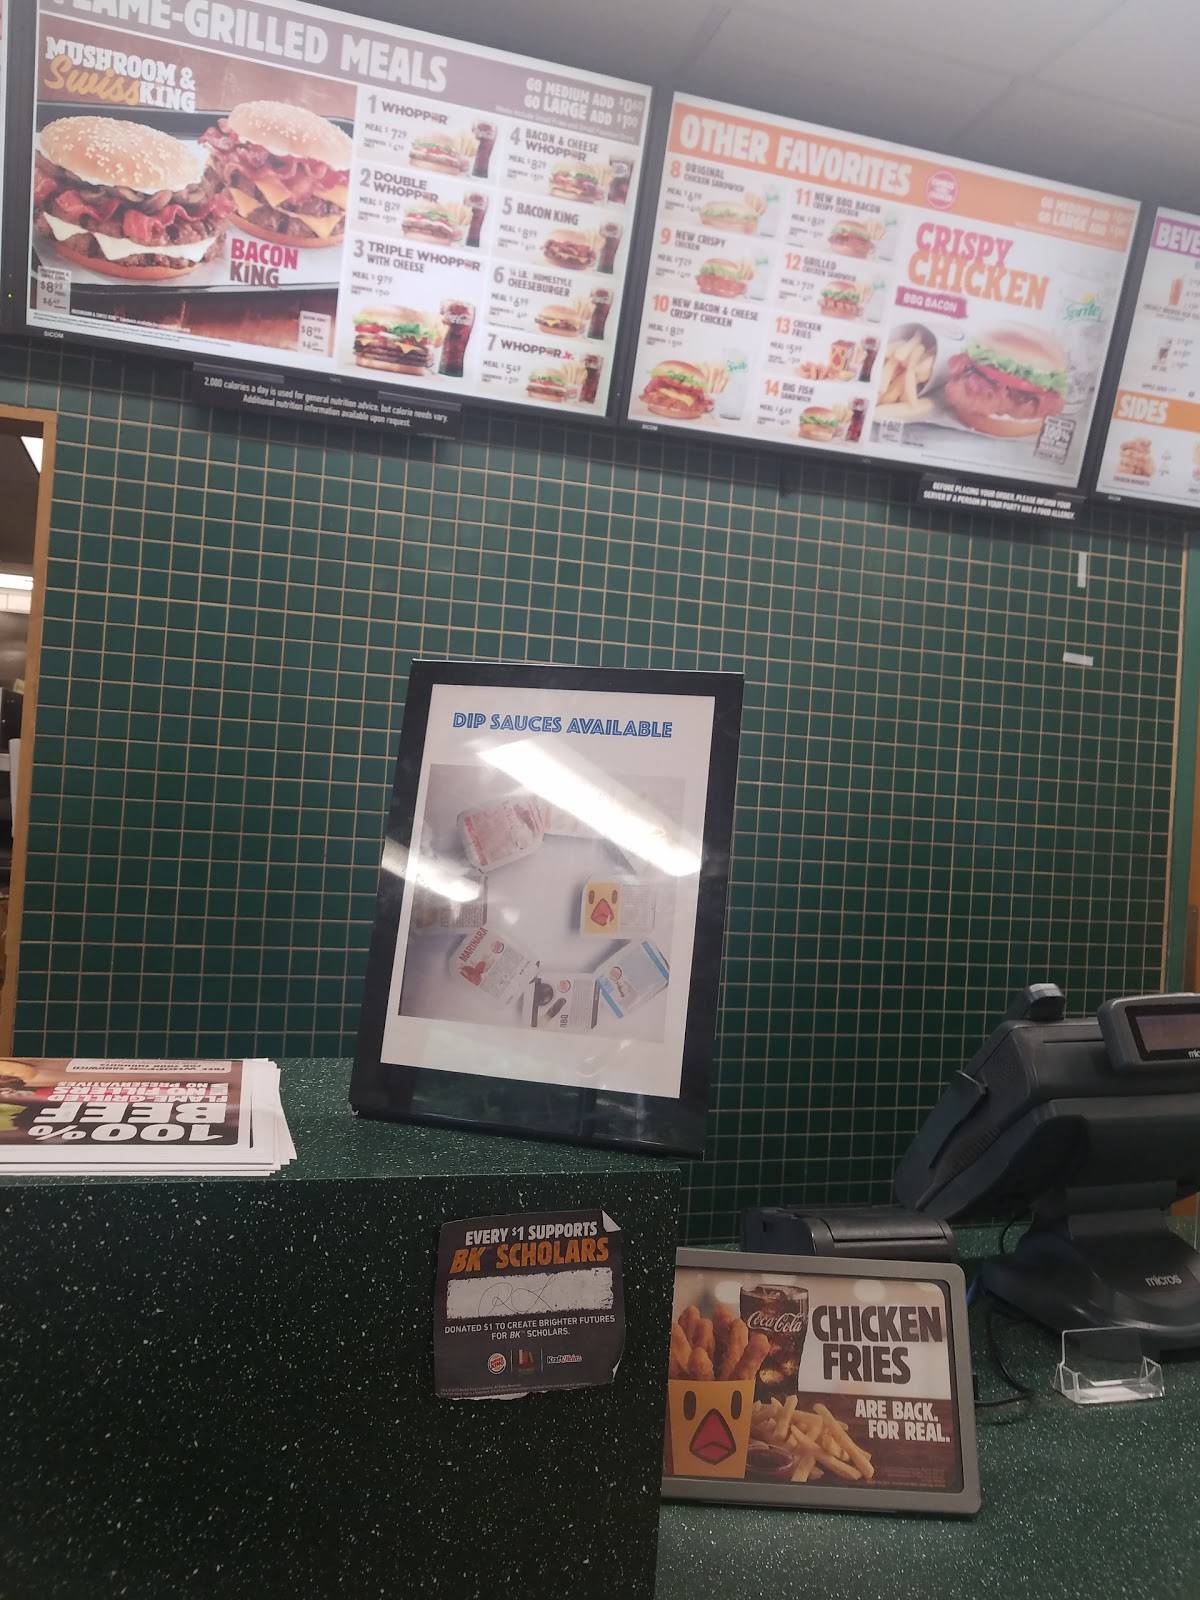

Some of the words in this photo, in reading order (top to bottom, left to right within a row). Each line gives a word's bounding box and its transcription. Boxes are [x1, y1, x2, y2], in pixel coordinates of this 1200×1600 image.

[45, 36, 175, 86] MUSHROOM
[179, 67, 196, 90] &
[340, 33, 448, 93] MEALS
[44, 54, 141, 106] Swiss
[139, 83, 196, 113] KING
[526, 77, 542, 92] GO
[544, 81, 590, 103] MEDIUM
[592, 92, 614, 108] ADD
[368, 94, 377, 114] 1
[524, 95, 540, 109] GO
[543, 96, 587, 120] LARGE
[589, 110, 612, 126] ADD
[365, 123, 382, 133] MEAL
[510, 126, 521, 145] 4
[525, 128, 555, 145] BACON
[558, 136, 564, 146] &
[567, 136, 600, 154] CHEESE
[508, 154, 525, 165] MEAL
[680, 114, 770, 165] OTHER
[776, 135, 912, 197] FAVORITES
[360, 168, 371, 188] 2
[374, 170, 428, 190] DOUBLE
[671, 160, 681, 178] 8
[685, 162, 724, 180] ORIGINAL
[502, 196, 512, 215] 5
[516, 202, 551, 221] BACON
[553, 210, 579, 226] KING
[796, 188, 810, 207] 11
[814, 192, 834, 203] NEW
[855, 201, 881, 214] BACON
[353, 239, 364, 258] 3
[367, 241, 414, 259] TRIPLE
[660, 227, 672, 245] 9
[675, 229, 695, 242] NEW
[698, 235, 726, 248] CRISPY
[674, 240, 700, 251] CHICKEN
[916, 222, 1014, 268] CRISPY
[230, 237, 298, 270] BACON
[367, 254, 390, 266] WITH
[393, 258, 425, 273] CHEESE
[785, 251, 801, 271] 12
[804, 256, 837, 270] GRILLED
[229, 260, 279, 289] KING
[493, 266, 505, 284] 6
[908, 250, 1050, 311] CHICKEN
[508, 276, 570, 298] CHEESEBURGER
[653, 294, 669, 312] 10
[672, 297, 691, 309] NEW
[694, 301, 719, 314] BACON
[722, 307, 728, 315] &
[731, 308, 759, 321] CHEESE
[924, 297, 959, 313] BACON
[670, 308, 698, 321] CRISPY
[700, 315, 733, 328] CHICKEN
[776, 316, 791, 335] 13
[793, 319, 822, 332] CHICKEN
[488, 332, 497, 351] 7
[792, 329, 812, 339] FRIES
[223, 381, 250, 392] calories
[256, 385, 270, 397] day
[381, 403, 391, 414] but
[392, 406, 414, 417] calorie
[764, 378, 780, 397] 14
[782, 382, 796, 392] BIG
[798, 385, 815, 396] FISH
[1118, 394, 1168, 425] SIDES
[932, 481, 955, 492] BEFORE
[1016, 494, 1036, 504] PLEASE
[452, 712, 487, 729] DIP
[489, 713, 563, 734] SAUCES
[566, 717, 674, 739] AVAILABLE
[458, 926, 489, 963] MARINARA
[47, 1095, 228, 1103] FLAME-GRILLED
[53, 1086, 161, 1096] FILLERS
[165, 1087, 207, 1096] NO
[33, 1101, 227, 1124] BEEF
[27, 1123, 224, 1142] 100%
[466, 1228, 508, 1246] EVERY
[512, 1226, 524, 1241] $1
[528, 1221, 597, 1240] SUPPORTS
[450, 1247, 486, 1274] BK
[496, 1237, 609, 1269] SCHOLARS
[1145, 1274, 1183, 1288] micros
[445, 1324, 482, 1334] DONATED
[483, 1323, 493, 1332] $1
[496, 1322, 506, 1330] TO
[507, 1320, 537, 1330] CREATE
[539, 1317, 578, 1328] BRIGHTER
[580, 1315, 616, 1325] FUTURES
[491, 1331, 508, 1340] FOR
[526, 1327, 571, 1338] SCHOLARS.
[811, 1305, 943, 1343] CHICKEN
[822, 1343, 911, 1385] FRIES
[856, 1399, 887, 1419] ARE
[892, 1400, 939, 1422] BACK.
[868, 1420, 900, 1440] FOR
[904, 1422, 951, 1443] REAL.
